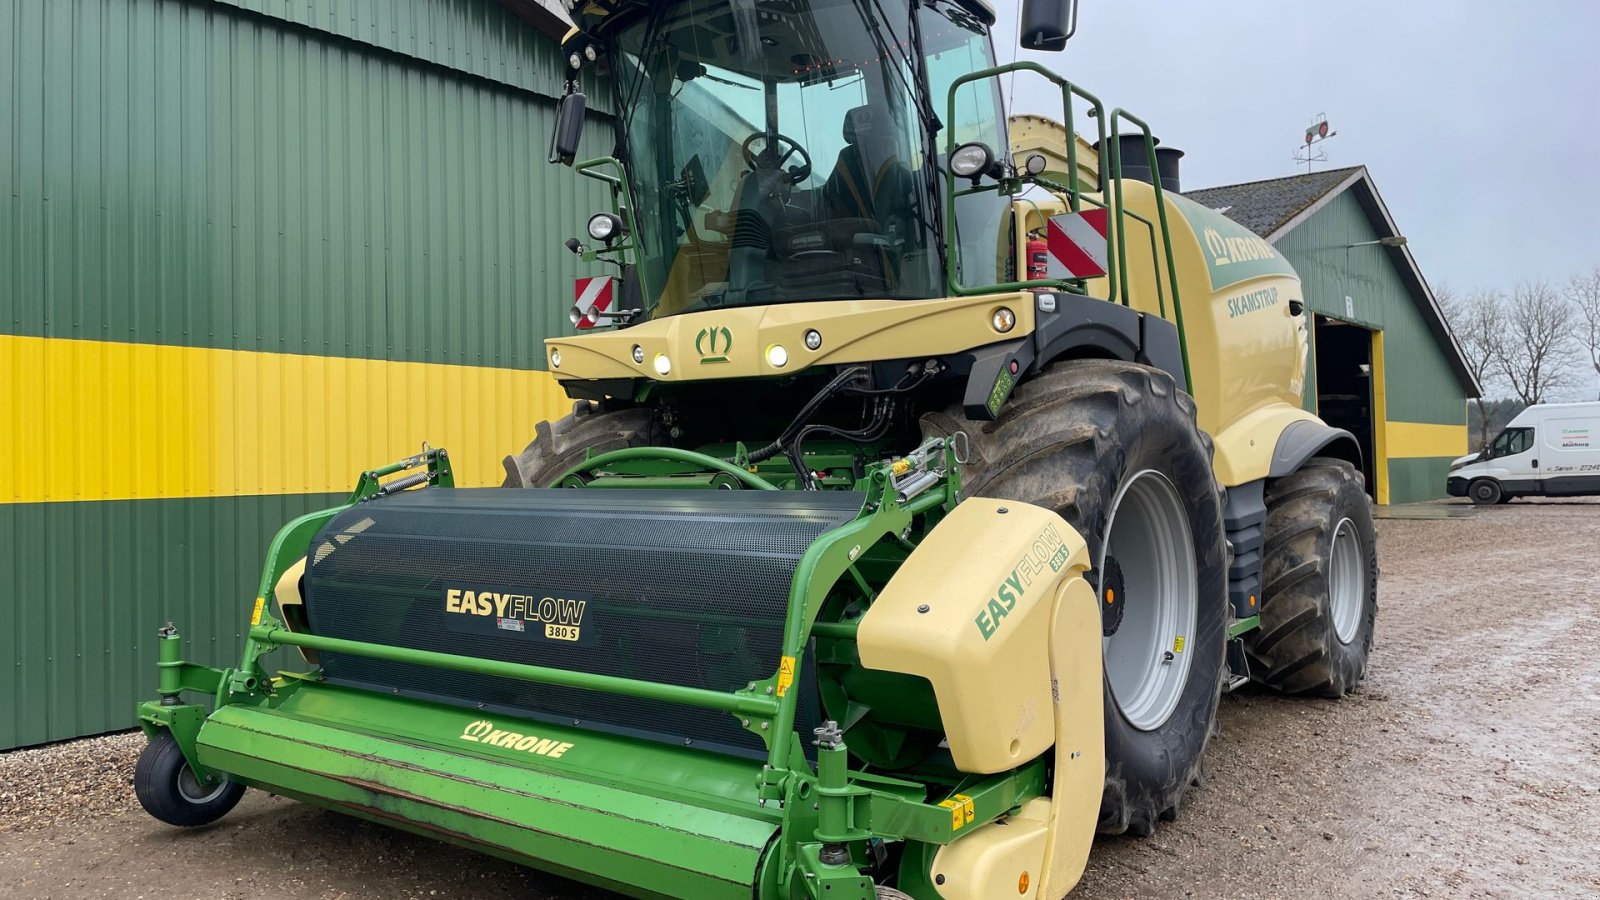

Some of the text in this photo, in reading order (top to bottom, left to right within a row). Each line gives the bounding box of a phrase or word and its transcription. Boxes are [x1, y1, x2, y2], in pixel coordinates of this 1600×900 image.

[1227, 287, 1278, 318] SKAMSTRUP
[974, 522, 1063, 642] EASYFLOW
[446, 588, 586, 626] EASYFLOW
[548, 626, 576, 639] 380 S
[481, 729, 575, 758] KRONE
